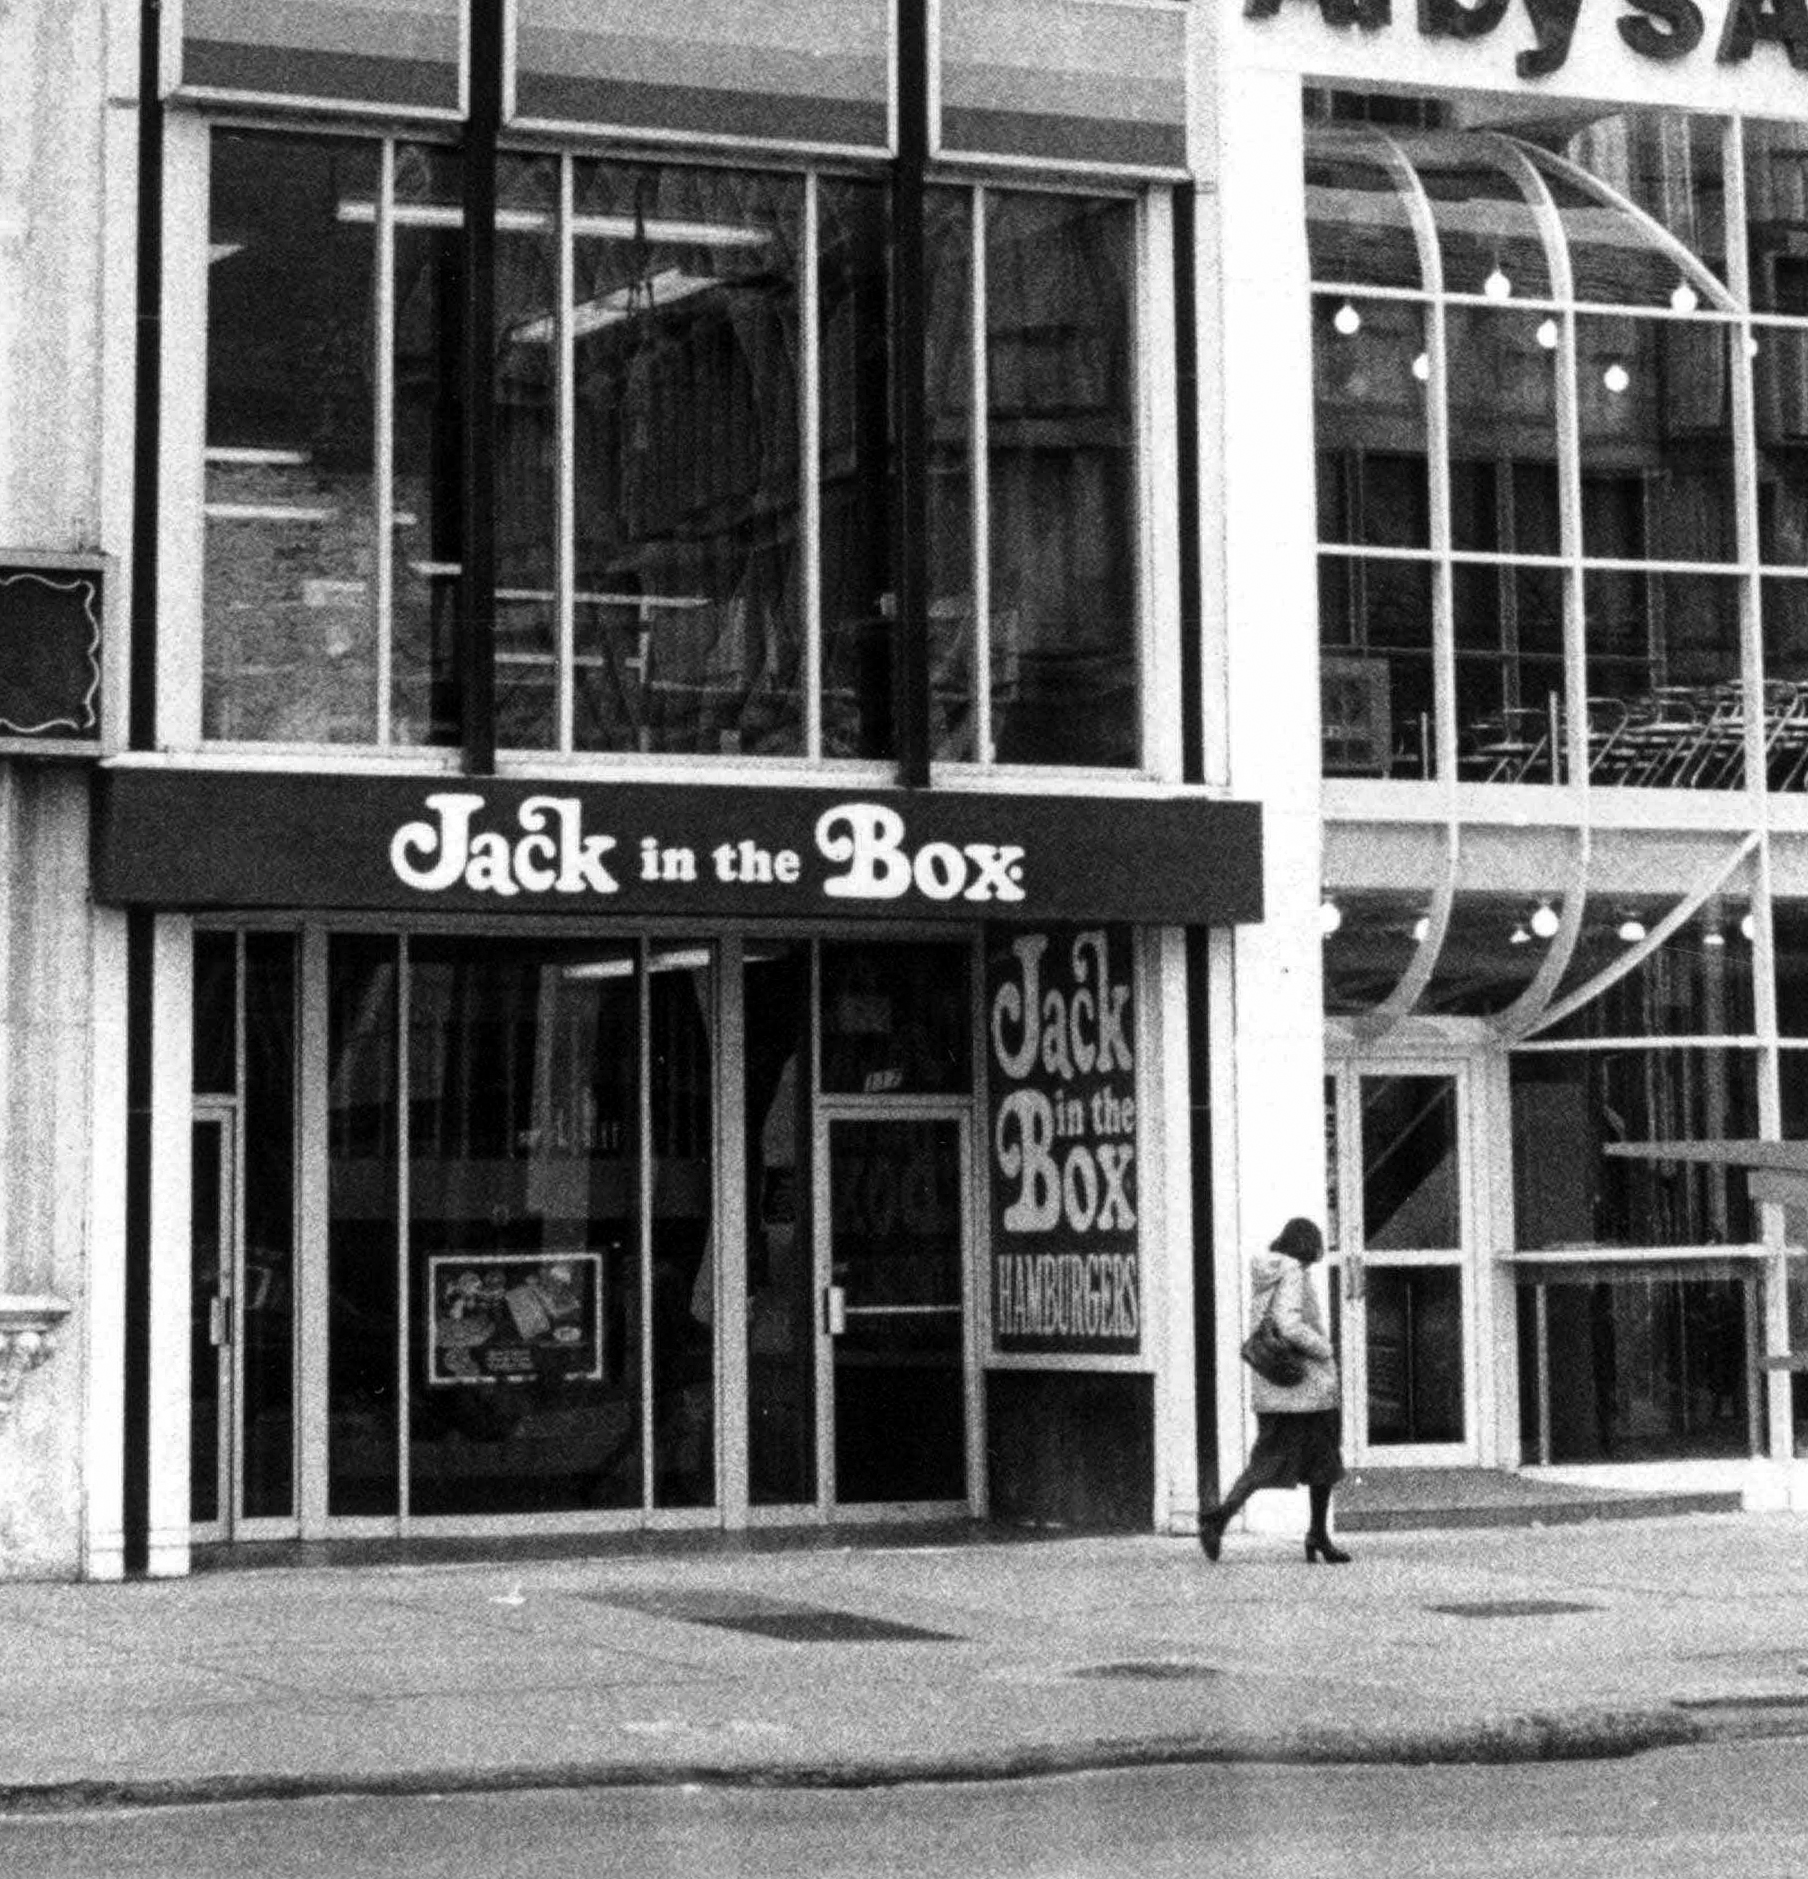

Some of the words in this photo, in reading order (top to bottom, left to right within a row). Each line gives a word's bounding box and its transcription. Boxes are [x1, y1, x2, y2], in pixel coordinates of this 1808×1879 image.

[390, 793, 620, 896] Jack
[639, 837, 697, 882] in
[711, 839, 801, 885] the
[814, 802, 1026, 903] Box
[992, 930, 1134, 1082] Jack
[995, 1088, 1139, 1233] Box
[1054, 1089, 1085, 1138] in
[1090, 1085, 1137, 1136] the
[997, 1252, 1140, 1337] HAMBURGERS
